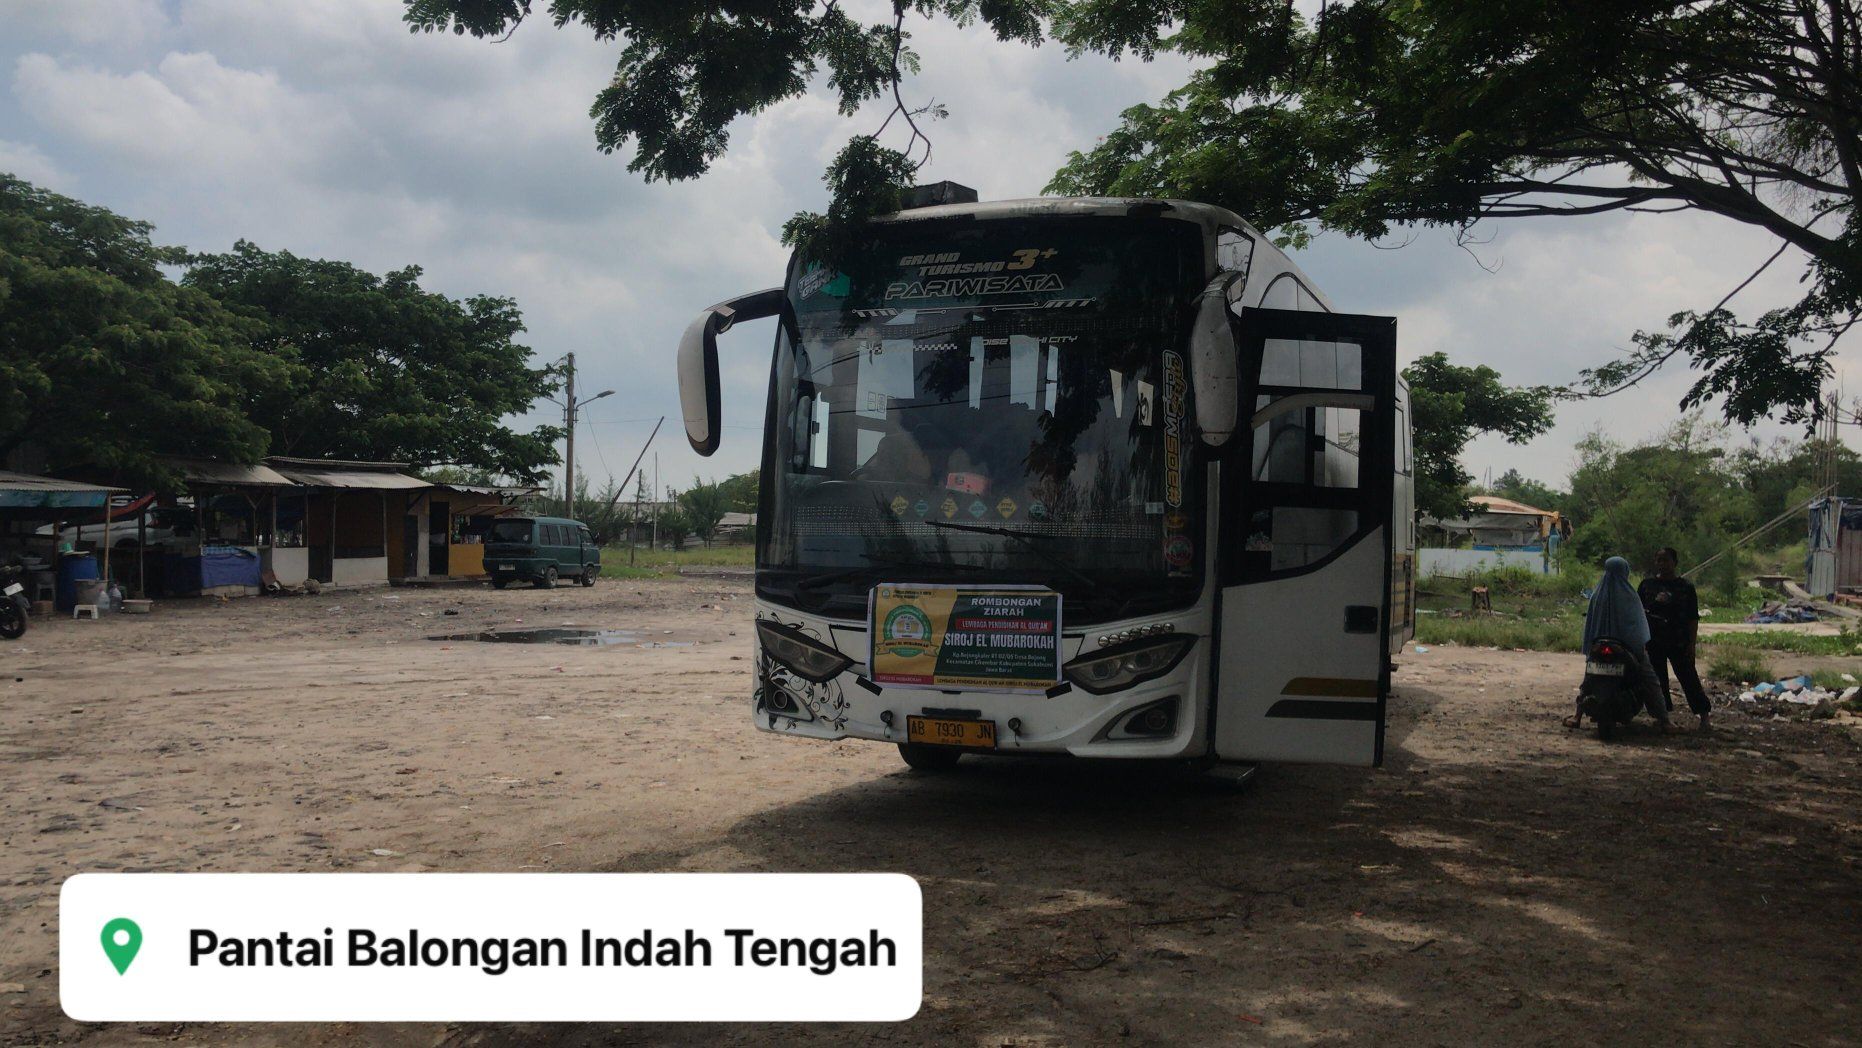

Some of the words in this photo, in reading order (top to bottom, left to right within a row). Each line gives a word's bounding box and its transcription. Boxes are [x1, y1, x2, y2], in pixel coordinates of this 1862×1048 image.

[899, 252, 960, 266] GRAND
[919, 261, 1006, 276] TURISMO
[885, 273, 1064, 300] PARIWISATA
[971, 598, 1041, 607] ROMBONGAN
[983, 608, 1024, 617] ZIARAH
[962, 620, 988, 629] LEMBAGA
[944, 633, 974, 647] SIROJ
[976, 634, 987, 648] EL
[990, 634, 1055, 650] MUBAROKAH
[911, 721, 925, 736] AB
[935, 722, 964, 738] 7930
[976, 724, 992, 739] JN
